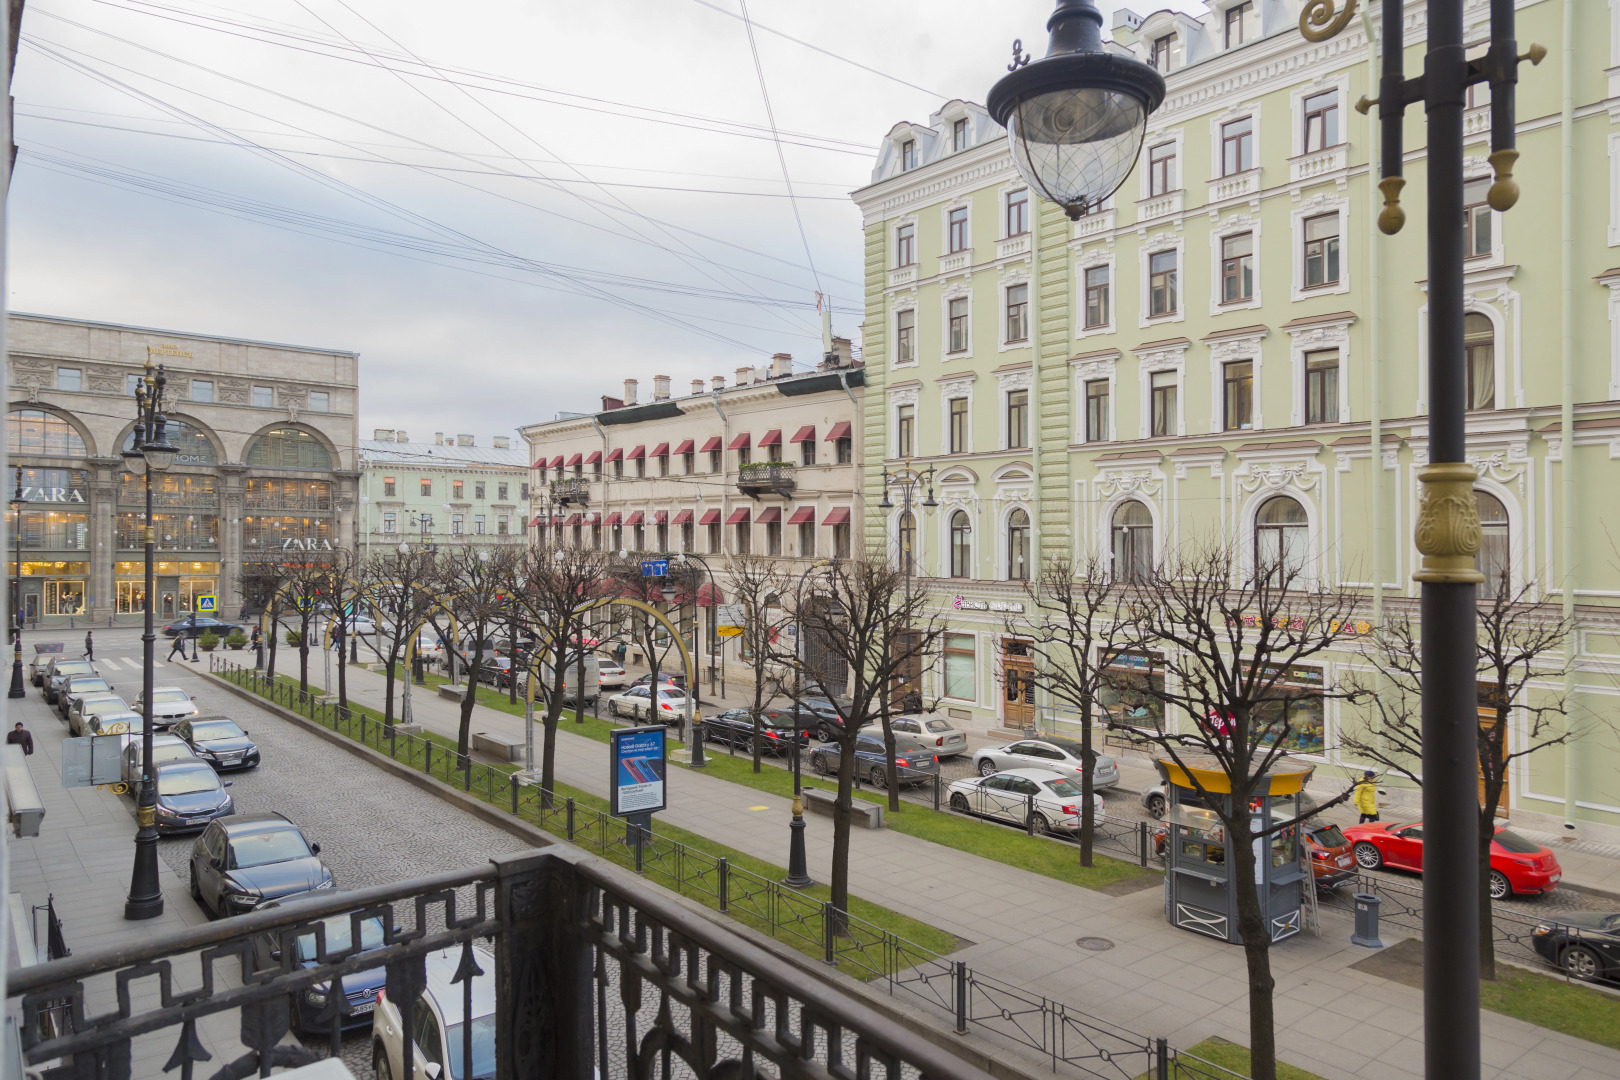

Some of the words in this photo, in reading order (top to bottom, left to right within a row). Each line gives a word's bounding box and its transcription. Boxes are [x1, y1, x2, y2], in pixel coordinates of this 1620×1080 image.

[21, 486, 86, 503] ZARA
[281, 537, 332, 551] ZARA
[1330, 620, 1372, 634] РАЙ
